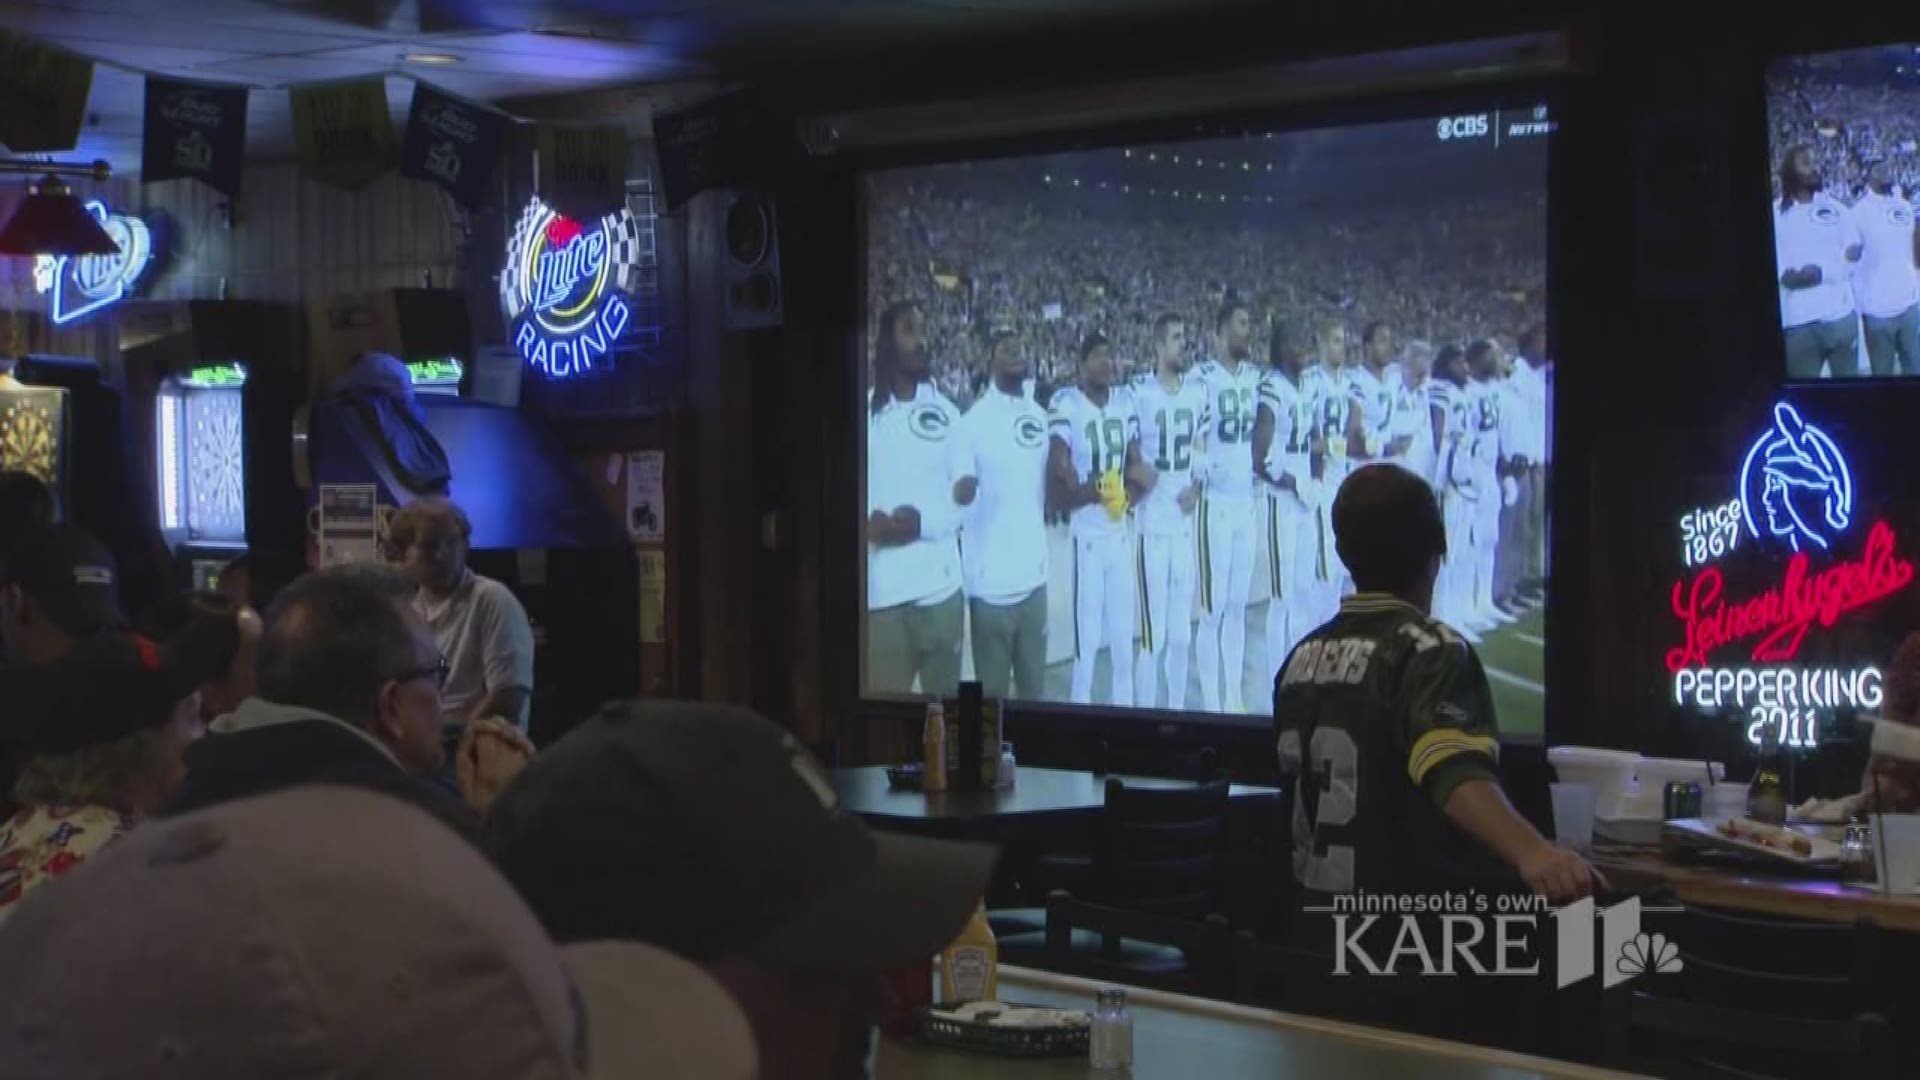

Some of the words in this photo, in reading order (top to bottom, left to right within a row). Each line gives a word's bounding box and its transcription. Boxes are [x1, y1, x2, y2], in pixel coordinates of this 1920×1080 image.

[1453, 114, 1489, 138] CBS
[533, 229, 604, 312] Lite
[515, 294, 629, 377] RACING
[1155, 408, 1194, 472] 12
[1685, 520, 1740, 568] 1867
[1675, 667, 1798, 708] PEPPER
[1801, 666, 1884, 708] KING
